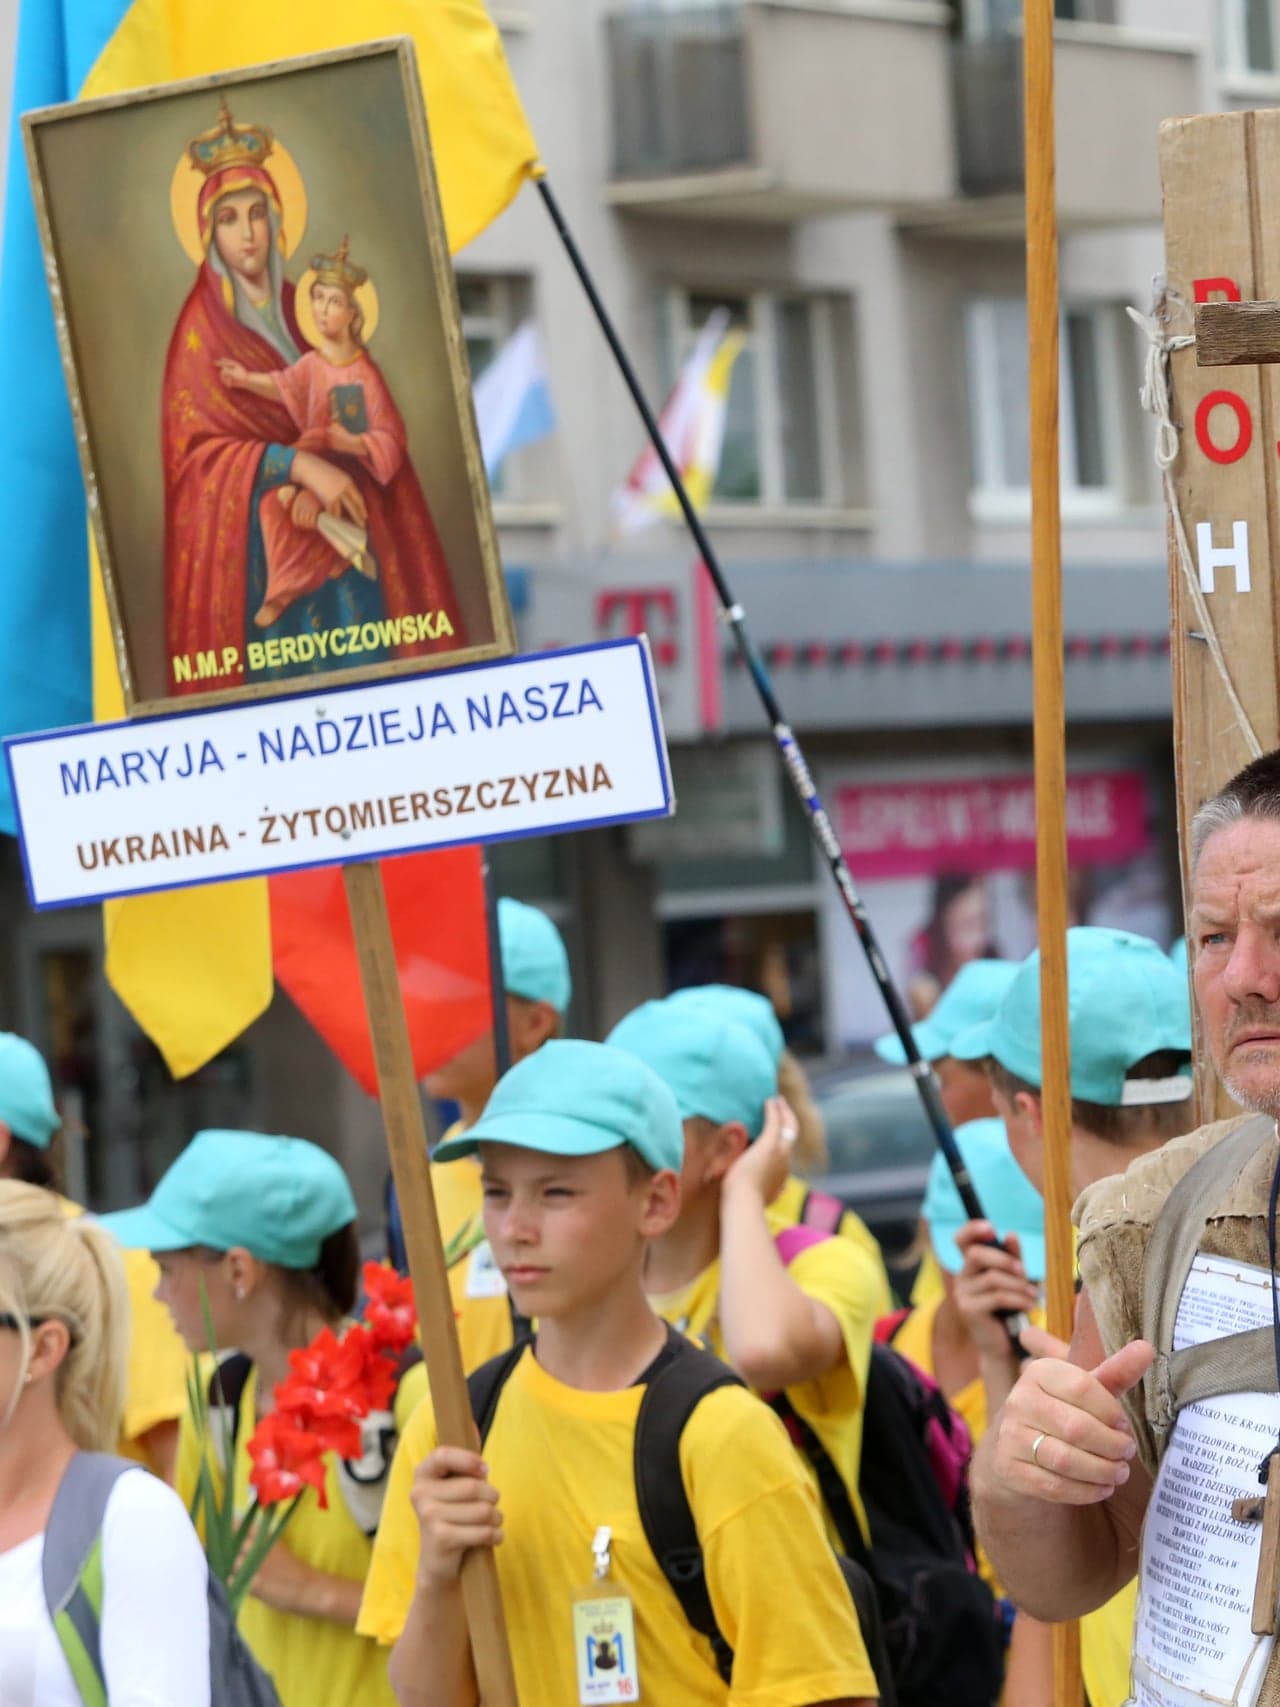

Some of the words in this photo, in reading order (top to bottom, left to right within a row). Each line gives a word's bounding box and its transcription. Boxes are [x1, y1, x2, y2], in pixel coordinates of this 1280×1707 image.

[173, 652, 244, 684] N.M.P.
[247, 609, 455, 671] BERDYCZOWSKA
[59, 739, 225, 796] MARYJA
[258, 702, 457, 765] NADZIEJA
[466, 677, 604, 732] NASZA
[76, 823, 230, 871] UKRAINA
[257, 761, 614, 844] ŻYTOMIERSZCZYZNA
